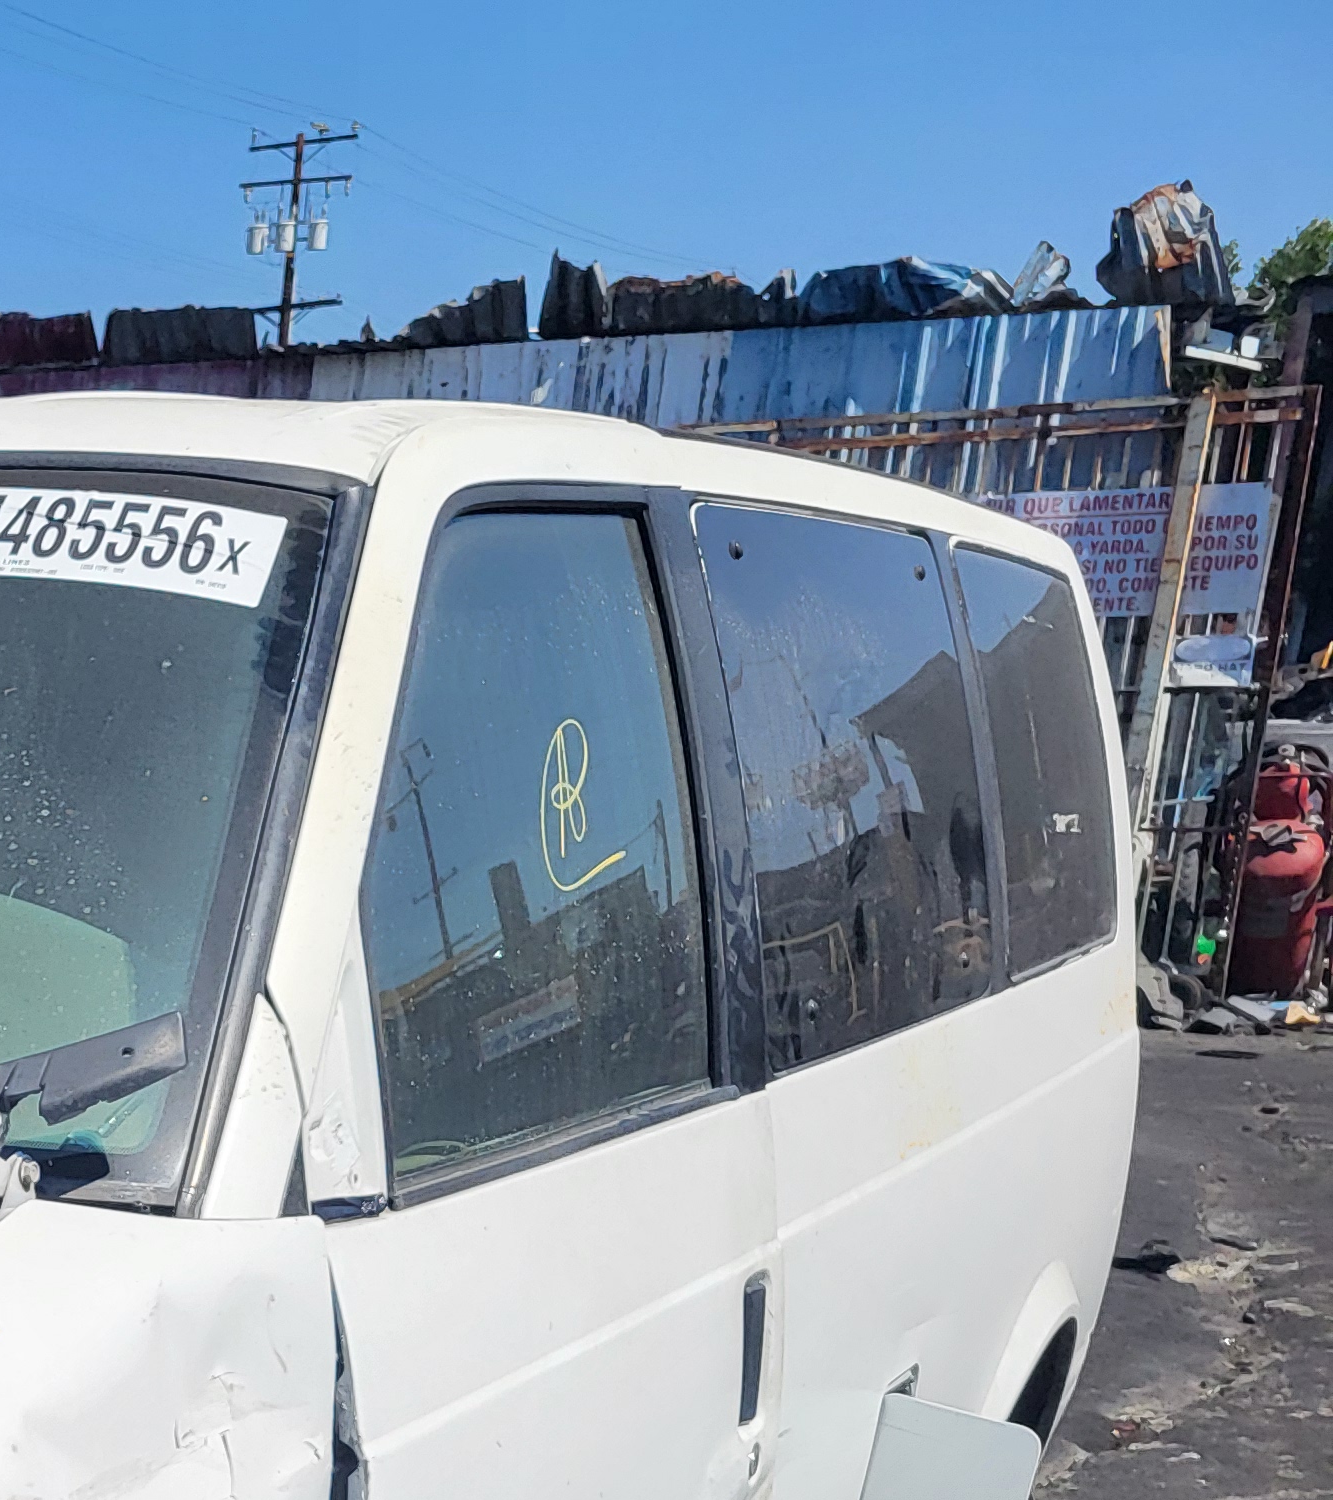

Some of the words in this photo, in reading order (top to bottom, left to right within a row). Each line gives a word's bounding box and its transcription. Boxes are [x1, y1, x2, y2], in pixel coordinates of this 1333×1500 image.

[1023, 496, 1064, 517] QUE
[1069, 492, 1171, 513] LAMENTAR
[1111, 518, 1156, 536] TODO
[1197, 513, 1258, 533] IEMPO
[1090, 538, 1150, 556] YARDA.
[1190, 535, 1228, 552] POR
[1235, 534, 1259, 551] SU
[1104, 558, 1127, 575] NO
[1134, 557, 1160, 574] TIE
[1190, 553, 1259, 573] EQUIPO
